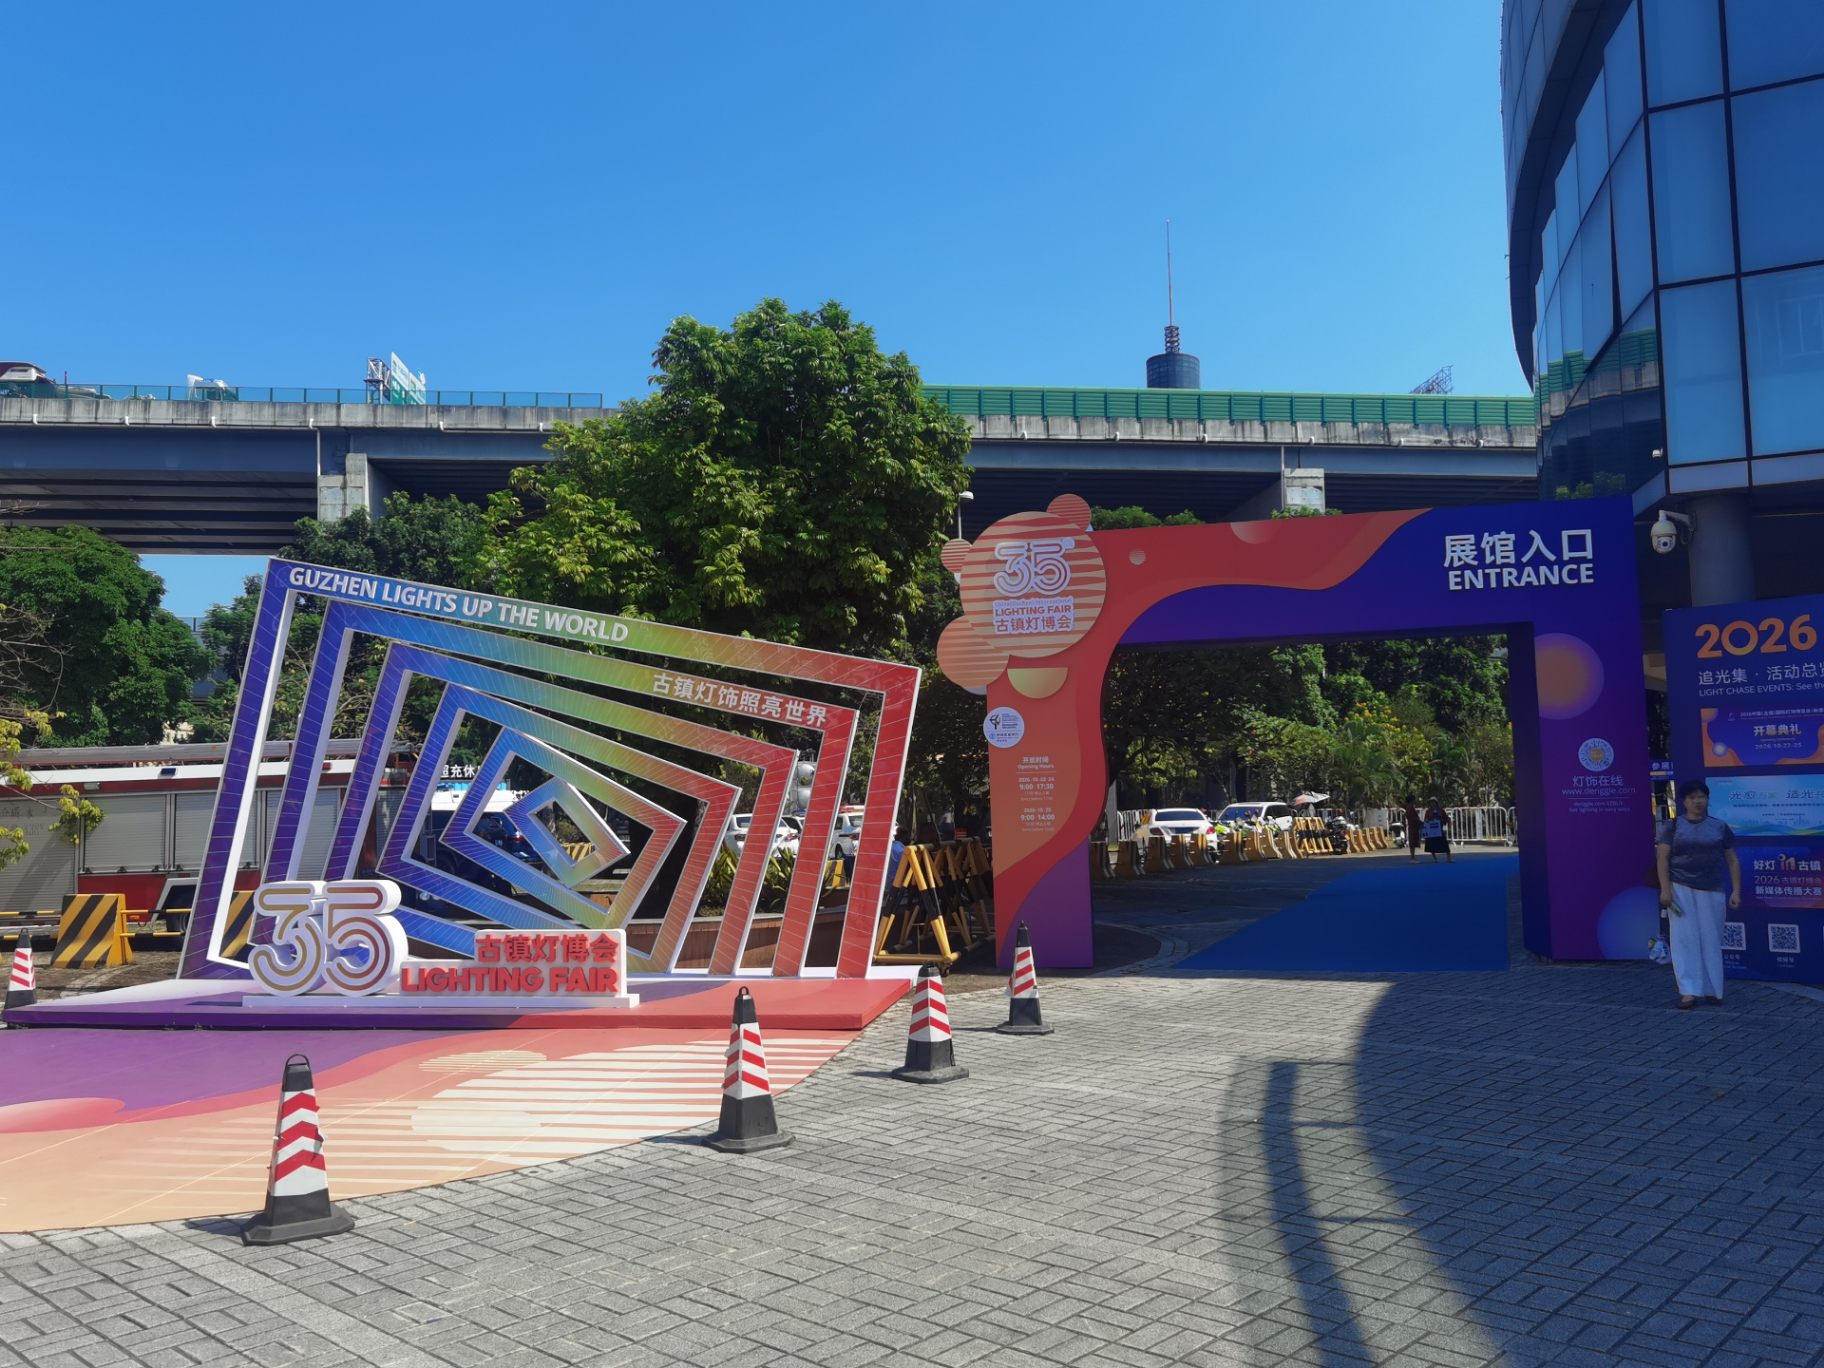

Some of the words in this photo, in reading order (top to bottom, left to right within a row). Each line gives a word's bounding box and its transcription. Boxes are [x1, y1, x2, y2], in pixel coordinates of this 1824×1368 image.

[1443, 529, 1593, 568] 展馆入口
[994, 541, 1072, 597] 35
[1448, 563, 1594, 590] ENTRANCE
[290, 566, 379, 599] GUZHEN
[381, 582, 457, 613] LIGHTS
[462, 597, 493, 618] UP
[498, 602, 539, 628] THE
[543, 610, 629, 642] WORLD
[995, 606, 1045, 617] LIGHTING
[1048, 604, 1072, 614] FAIR
[995, 614, 1071, 632] 古镇灯博会
[1695, 614, 1818, 659] 2026
[1698, 668, 1748, 686] 追光集
[1699, 688, 1723, 697] LIGHT
[1726, 685, 1755, 695] CHASE
[1796, 682, 1812, 690] See
[653, 672, 827, 727] 古镇灯饰照亮世界
[1572, 775, 1625, 788] 灯饰在线
[249, 880, 406, 997] 35
[476, 932, 619, 964] 古镇灯博会
[401, 967, 545, 994] LIGHTING
[553, 966, 620, 993] FAIR
